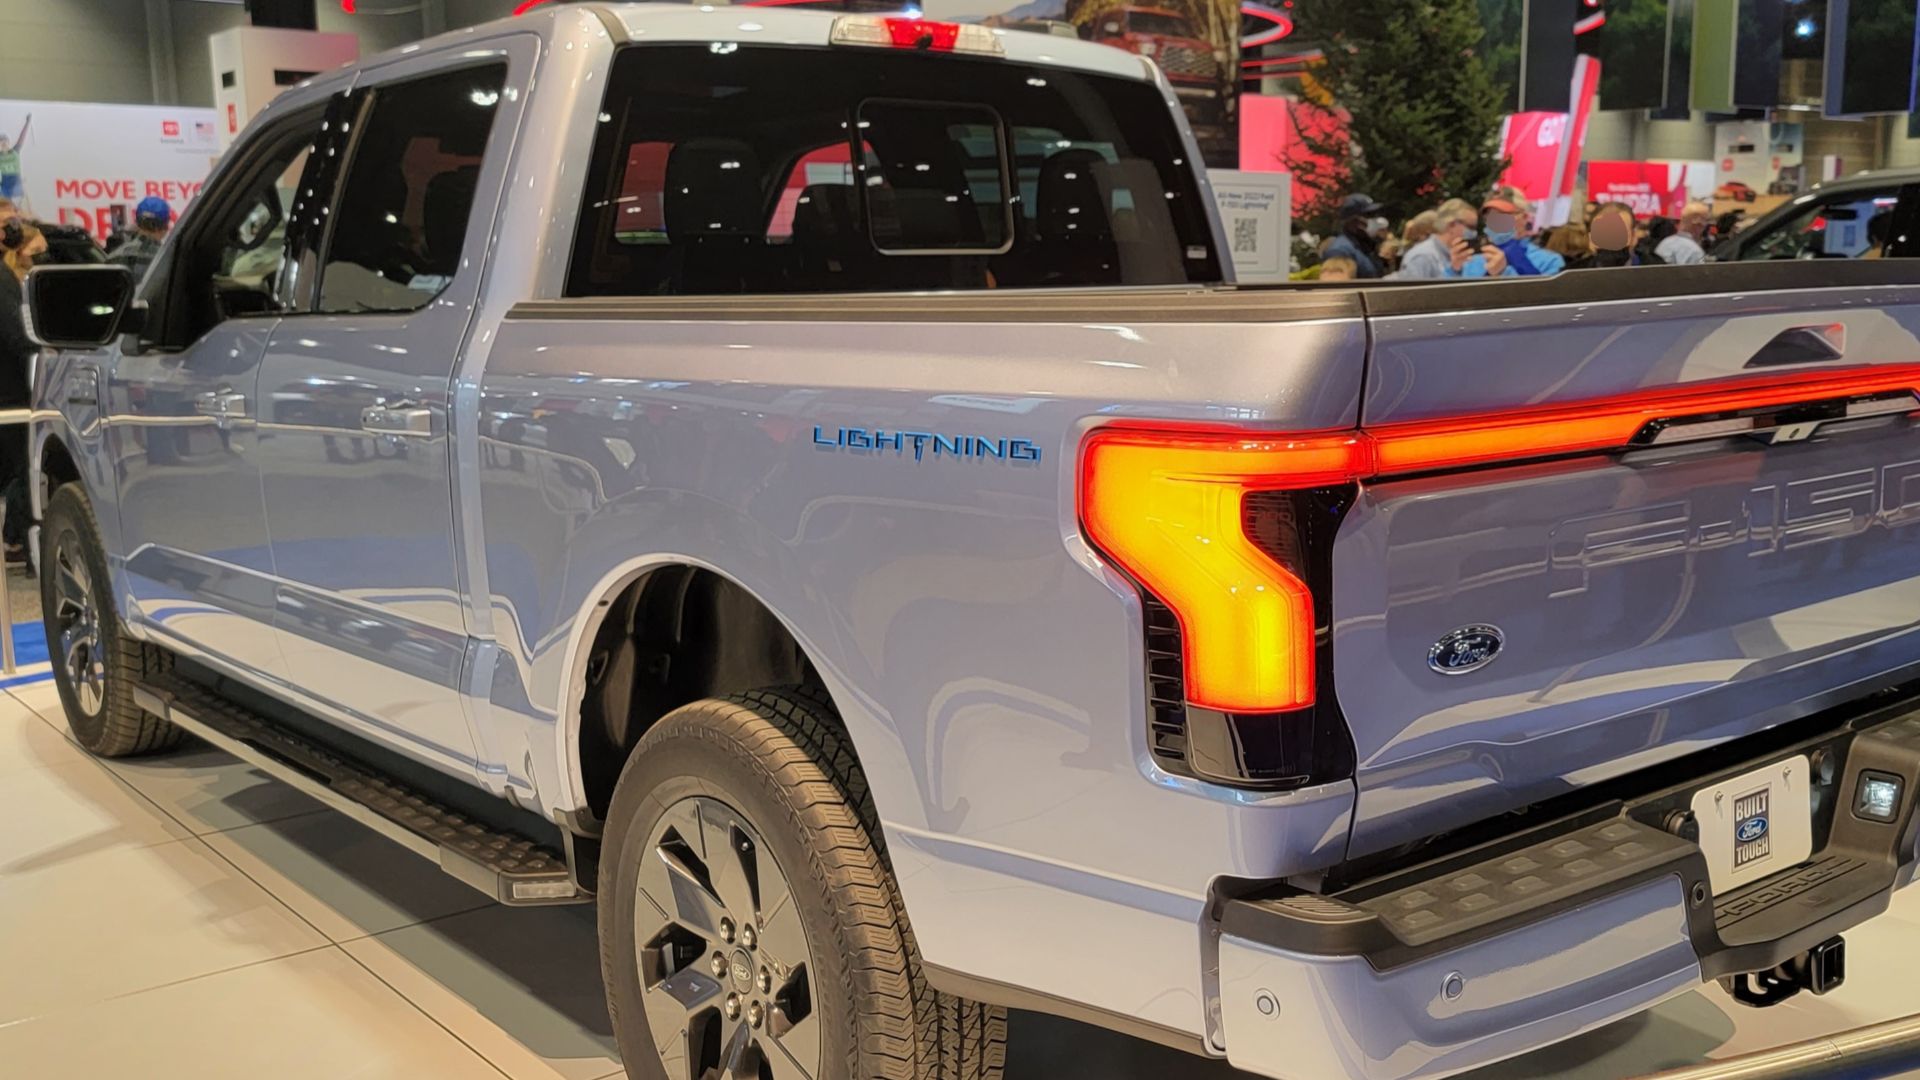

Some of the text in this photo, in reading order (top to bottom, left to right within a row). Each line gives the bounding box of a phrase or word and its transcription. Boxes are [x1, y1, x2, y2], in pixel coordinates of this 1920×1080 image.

[56, 179, 136, 199] MOVE
[813, 424, 1041, 463] LIGHTNING
[1735, 793, 1768, 821] BUILT
[1741, 819, 1764, 840] Ford
[1735, 839, 1769, 864] TOUGH
